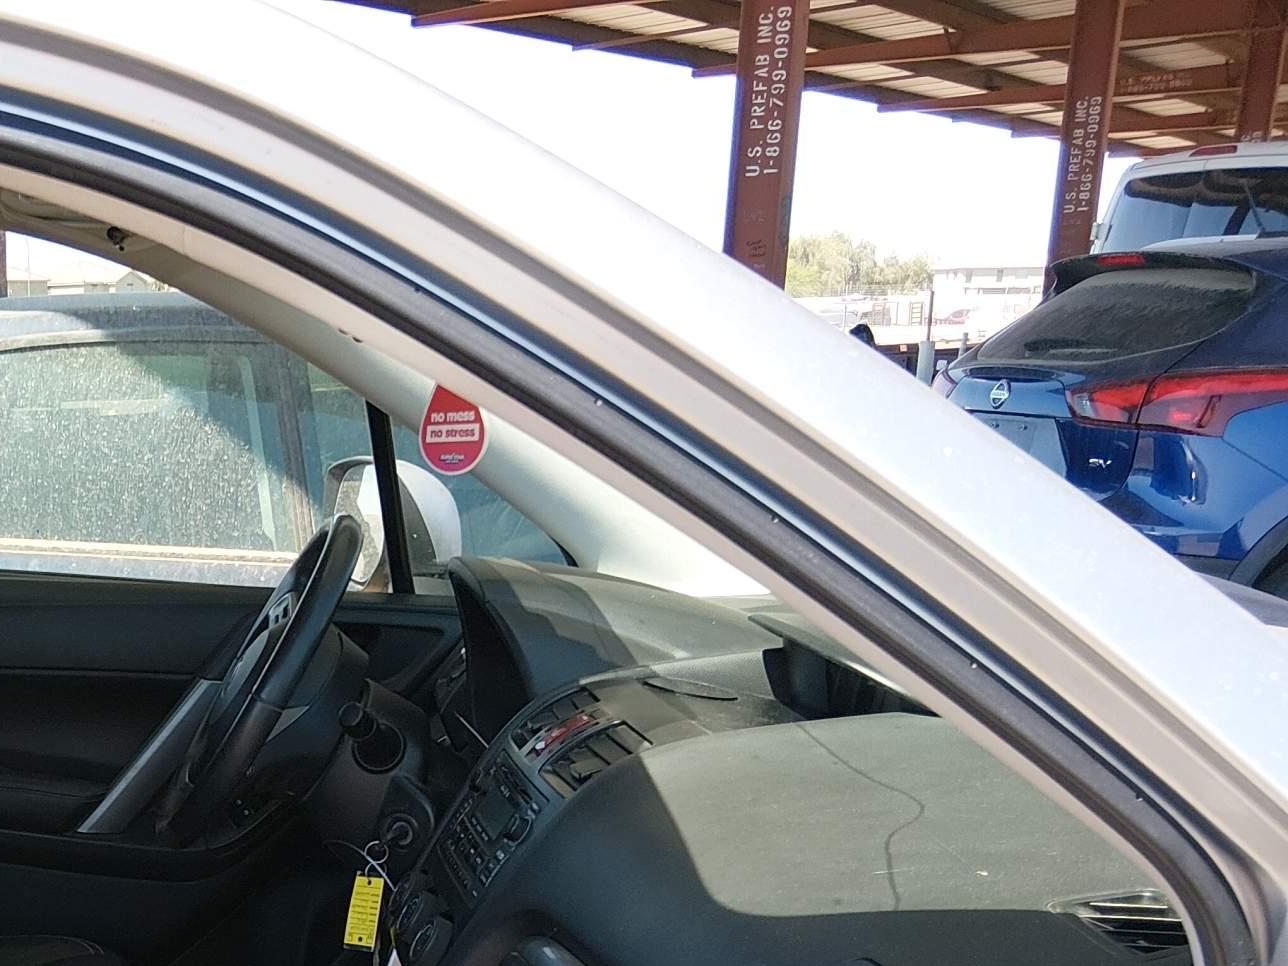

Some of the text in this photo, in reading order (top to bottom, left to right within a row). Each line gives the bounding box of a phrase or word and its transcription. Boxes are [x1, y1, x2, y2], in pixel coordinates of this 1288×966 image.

[745, 6, 775, 177] U.S. PREFAB INC.
[763, 6, 793, 174] 1-866-799-0969
[1063, 95, 1090, 213] U.S. PREFAB INC.
[1076, 96, 1103, 212] 1-866-799-0969
[430, 428, 475, 438] no stress
[431, 410, 475, 423] no mess
